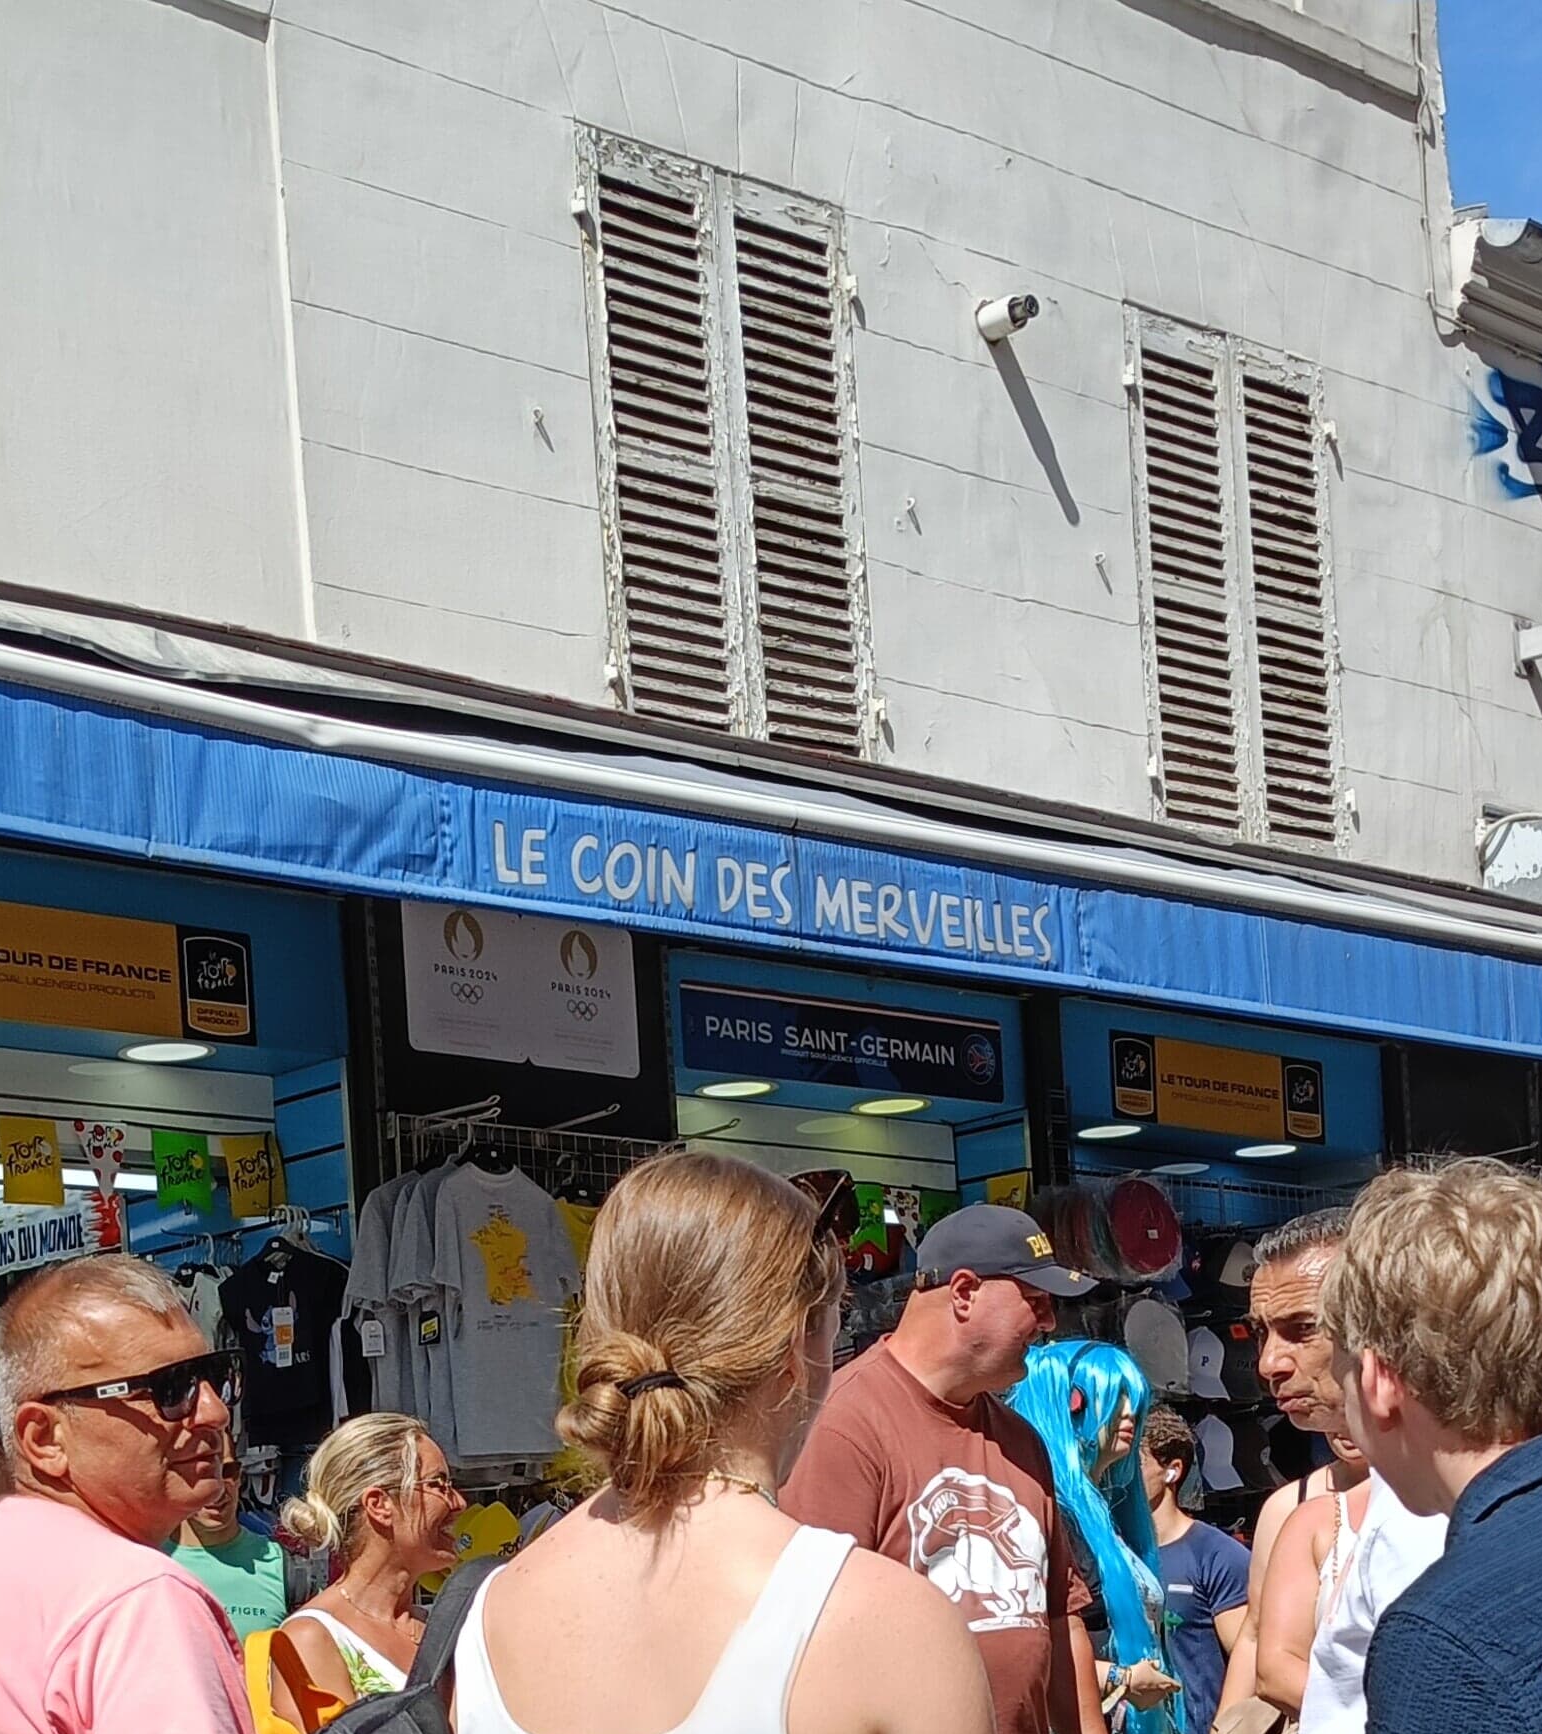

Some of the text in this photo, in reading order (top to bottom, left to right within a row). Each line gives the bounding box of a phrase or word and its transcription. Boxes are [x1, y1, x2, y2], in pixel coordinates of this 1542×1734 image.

[493, 819, 1052, 963] LE COIN DES MERVEILLES
[48, 955, 78, 973] DE
[82, 958, 172, 984] FRANCE
[433, 962, 499, 983] PARIS 2024
[25, 976, 87, 992] LICENSED
[88, 982, 156, 1000] PRODUCTS
[550, 981, 612, 1000] PARIS 2024
[704, 1015, 774, 1045] PARIS
[1160, 1072, 1176, 1086] LE
[1177, 1075, 1211, 1090] TOUR
[1213, 1080, 1230, 1093] DE
[1231, 1081, 1280, 1100] FRANCE
[17, 1224, 37, 1261] DU
[39, 1212, 85, 1253] MONDE
[224, 1606, 268, 1617] FIGER
